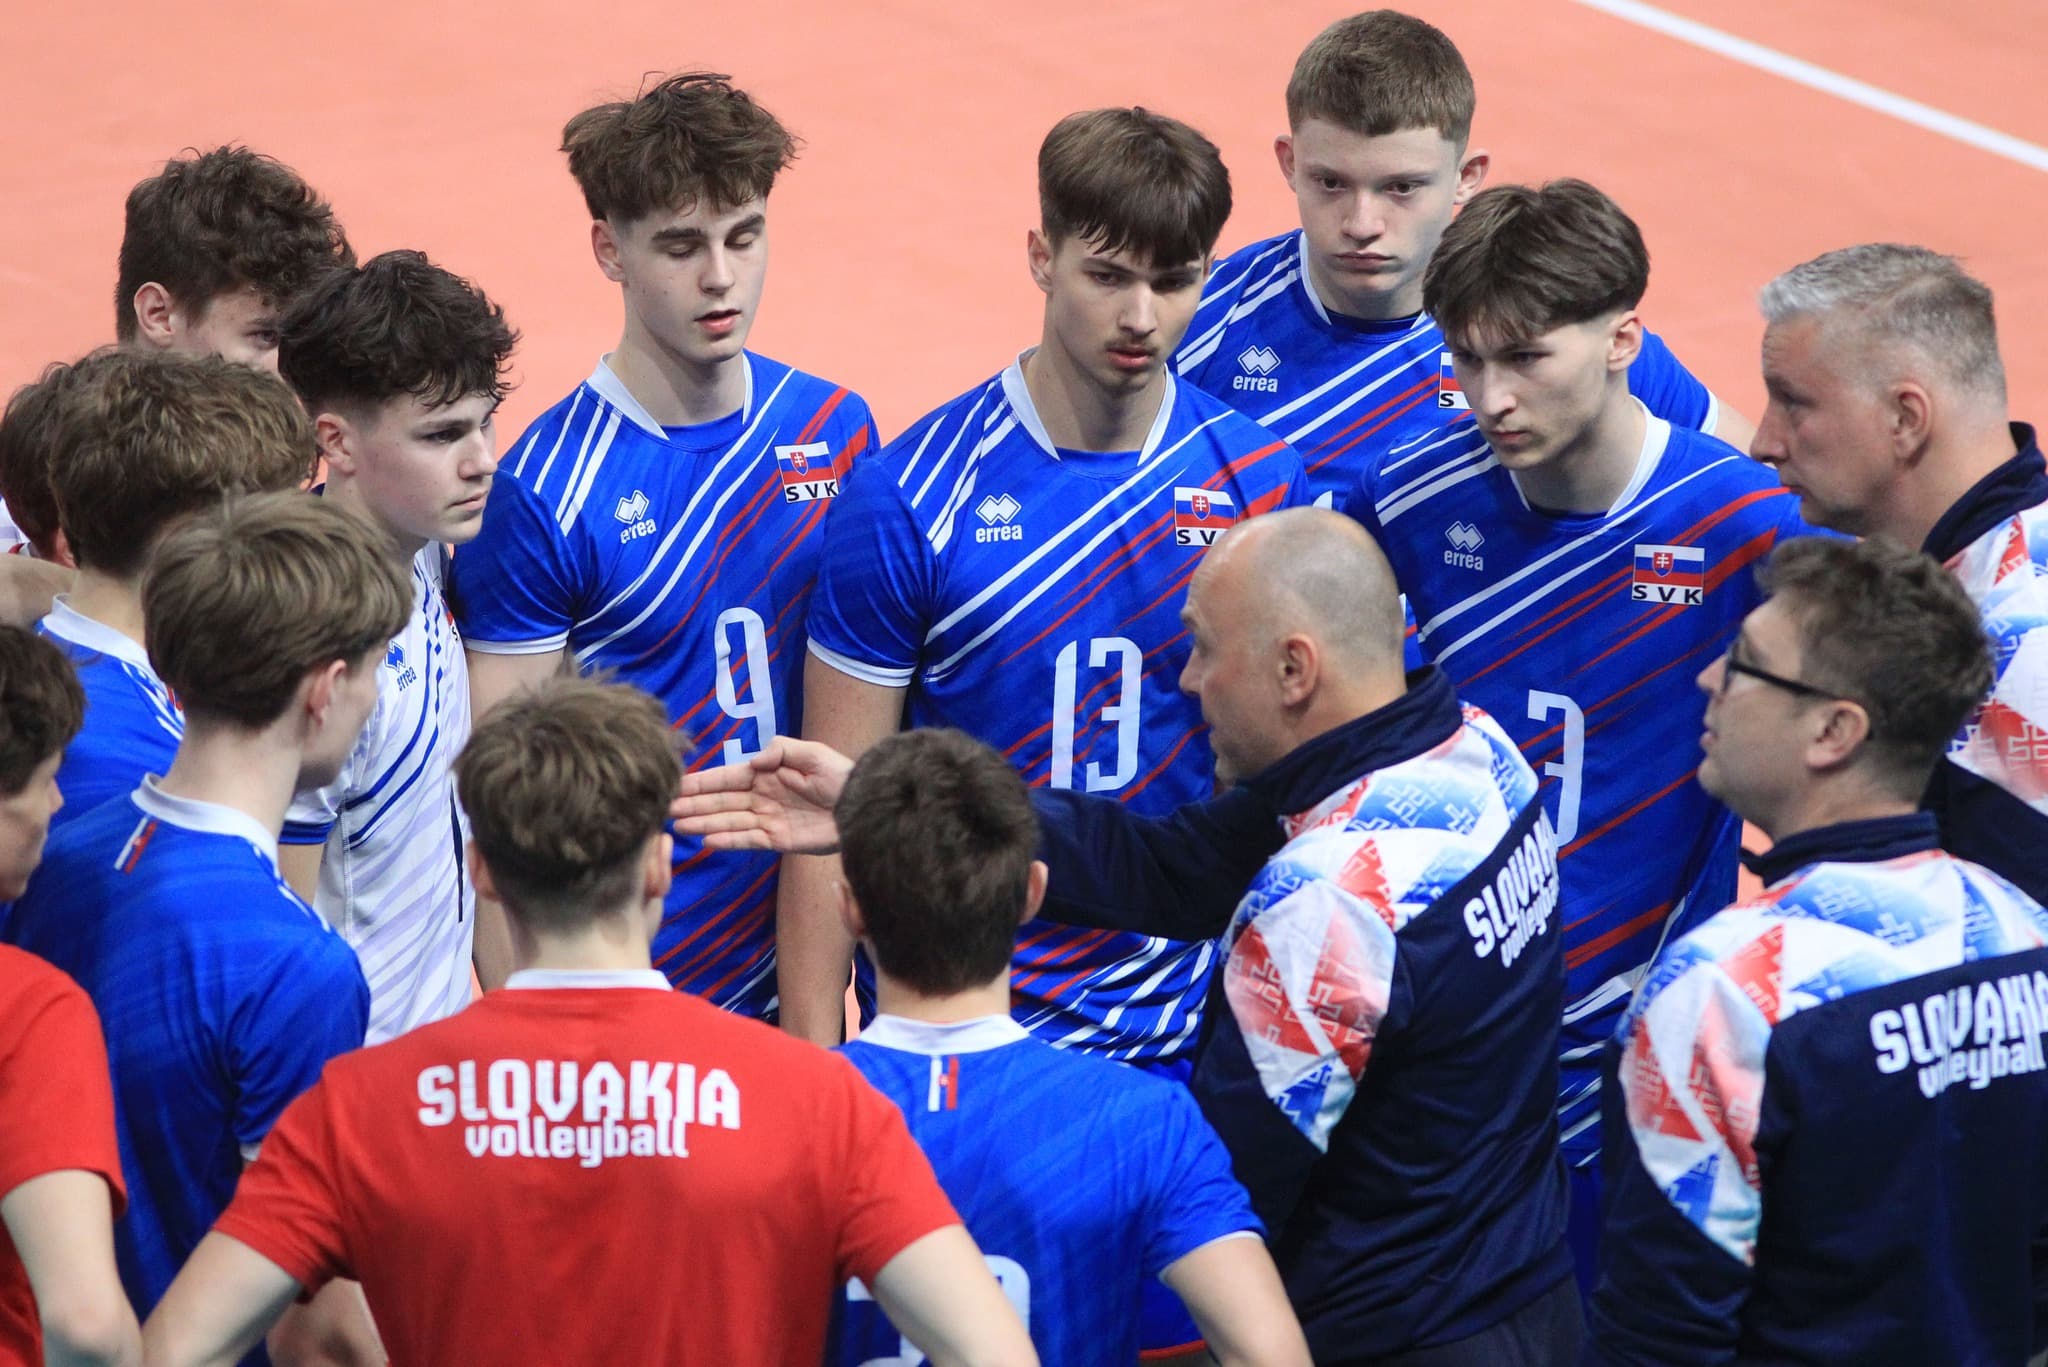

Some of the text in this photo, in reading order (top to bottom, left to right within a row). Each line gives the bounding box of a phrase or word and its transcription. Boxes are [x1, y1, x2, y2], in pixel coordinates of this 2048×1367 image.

[1232, 375, 1279, 393] errea
[785, 481, 838, 502] SVK
[620, 517, 657, 545] errea
[974, 523, 1023, 544] errea
[1176, 528, 1217, 545] SV
[1443, 550, 1485, 571] errea
[1632, 584, 1703, 605] SVK
[713, 606, 777, 767] 9
[1050, 636, 1143, 793] 13
[1527, 688, 1585, 848] 3
[1463, 805, 1559, 959] SLOVAK
[417, 1059, 741, 1130] SLOVAKIA
[465, 1115, 689, 1168] volleyball
